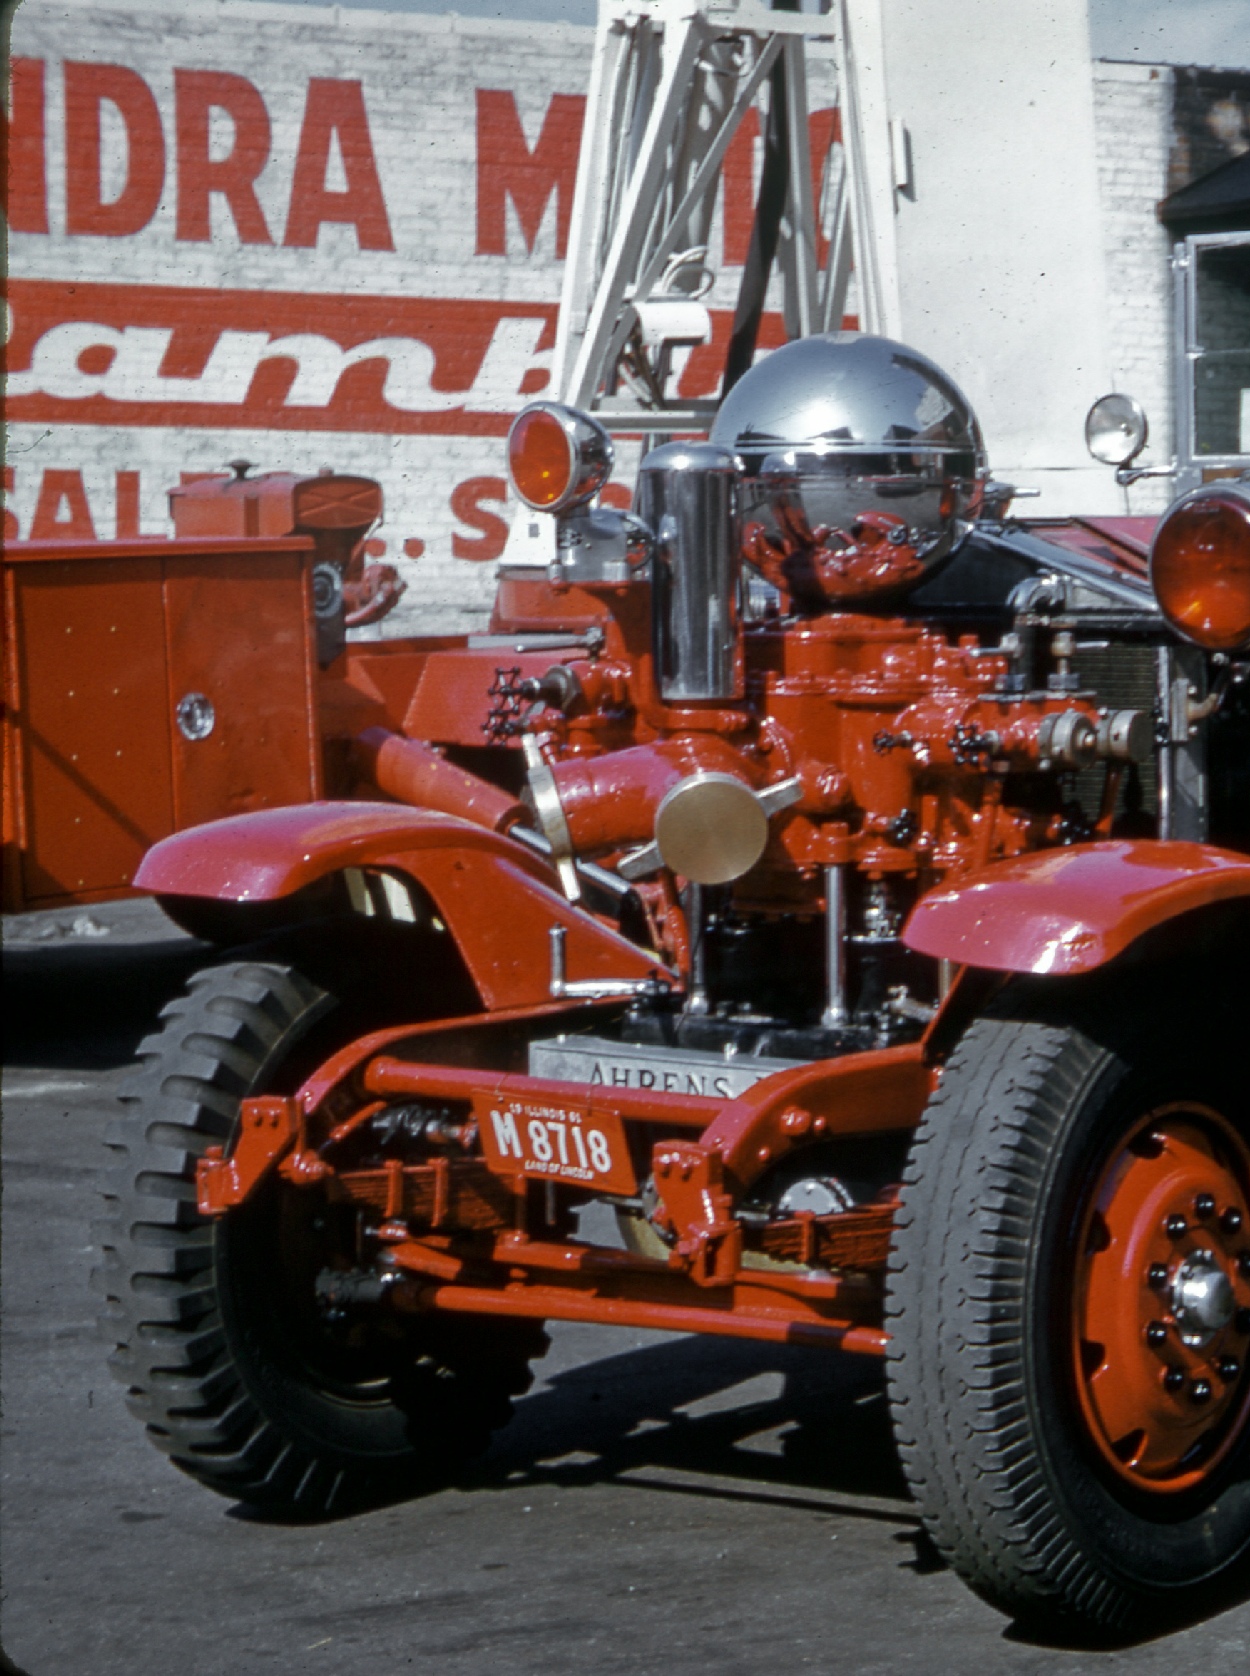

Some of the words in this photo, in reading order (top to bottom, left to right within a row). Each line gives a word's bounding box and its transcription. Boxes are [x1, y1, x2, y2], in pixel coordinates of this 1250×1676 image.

[590, 1062, 733, 1099] AHRENS
[524, 1105, 566, 1121] ILLINOIS
[489, 1109, 524, 1158] M
[527, 1119, 613, 1174] 8718
[524, 1159, 548, 1173] LAND
[548, 1162, 561, 1174] OF
[560, 1165, 595, 1180] LINCOLN
